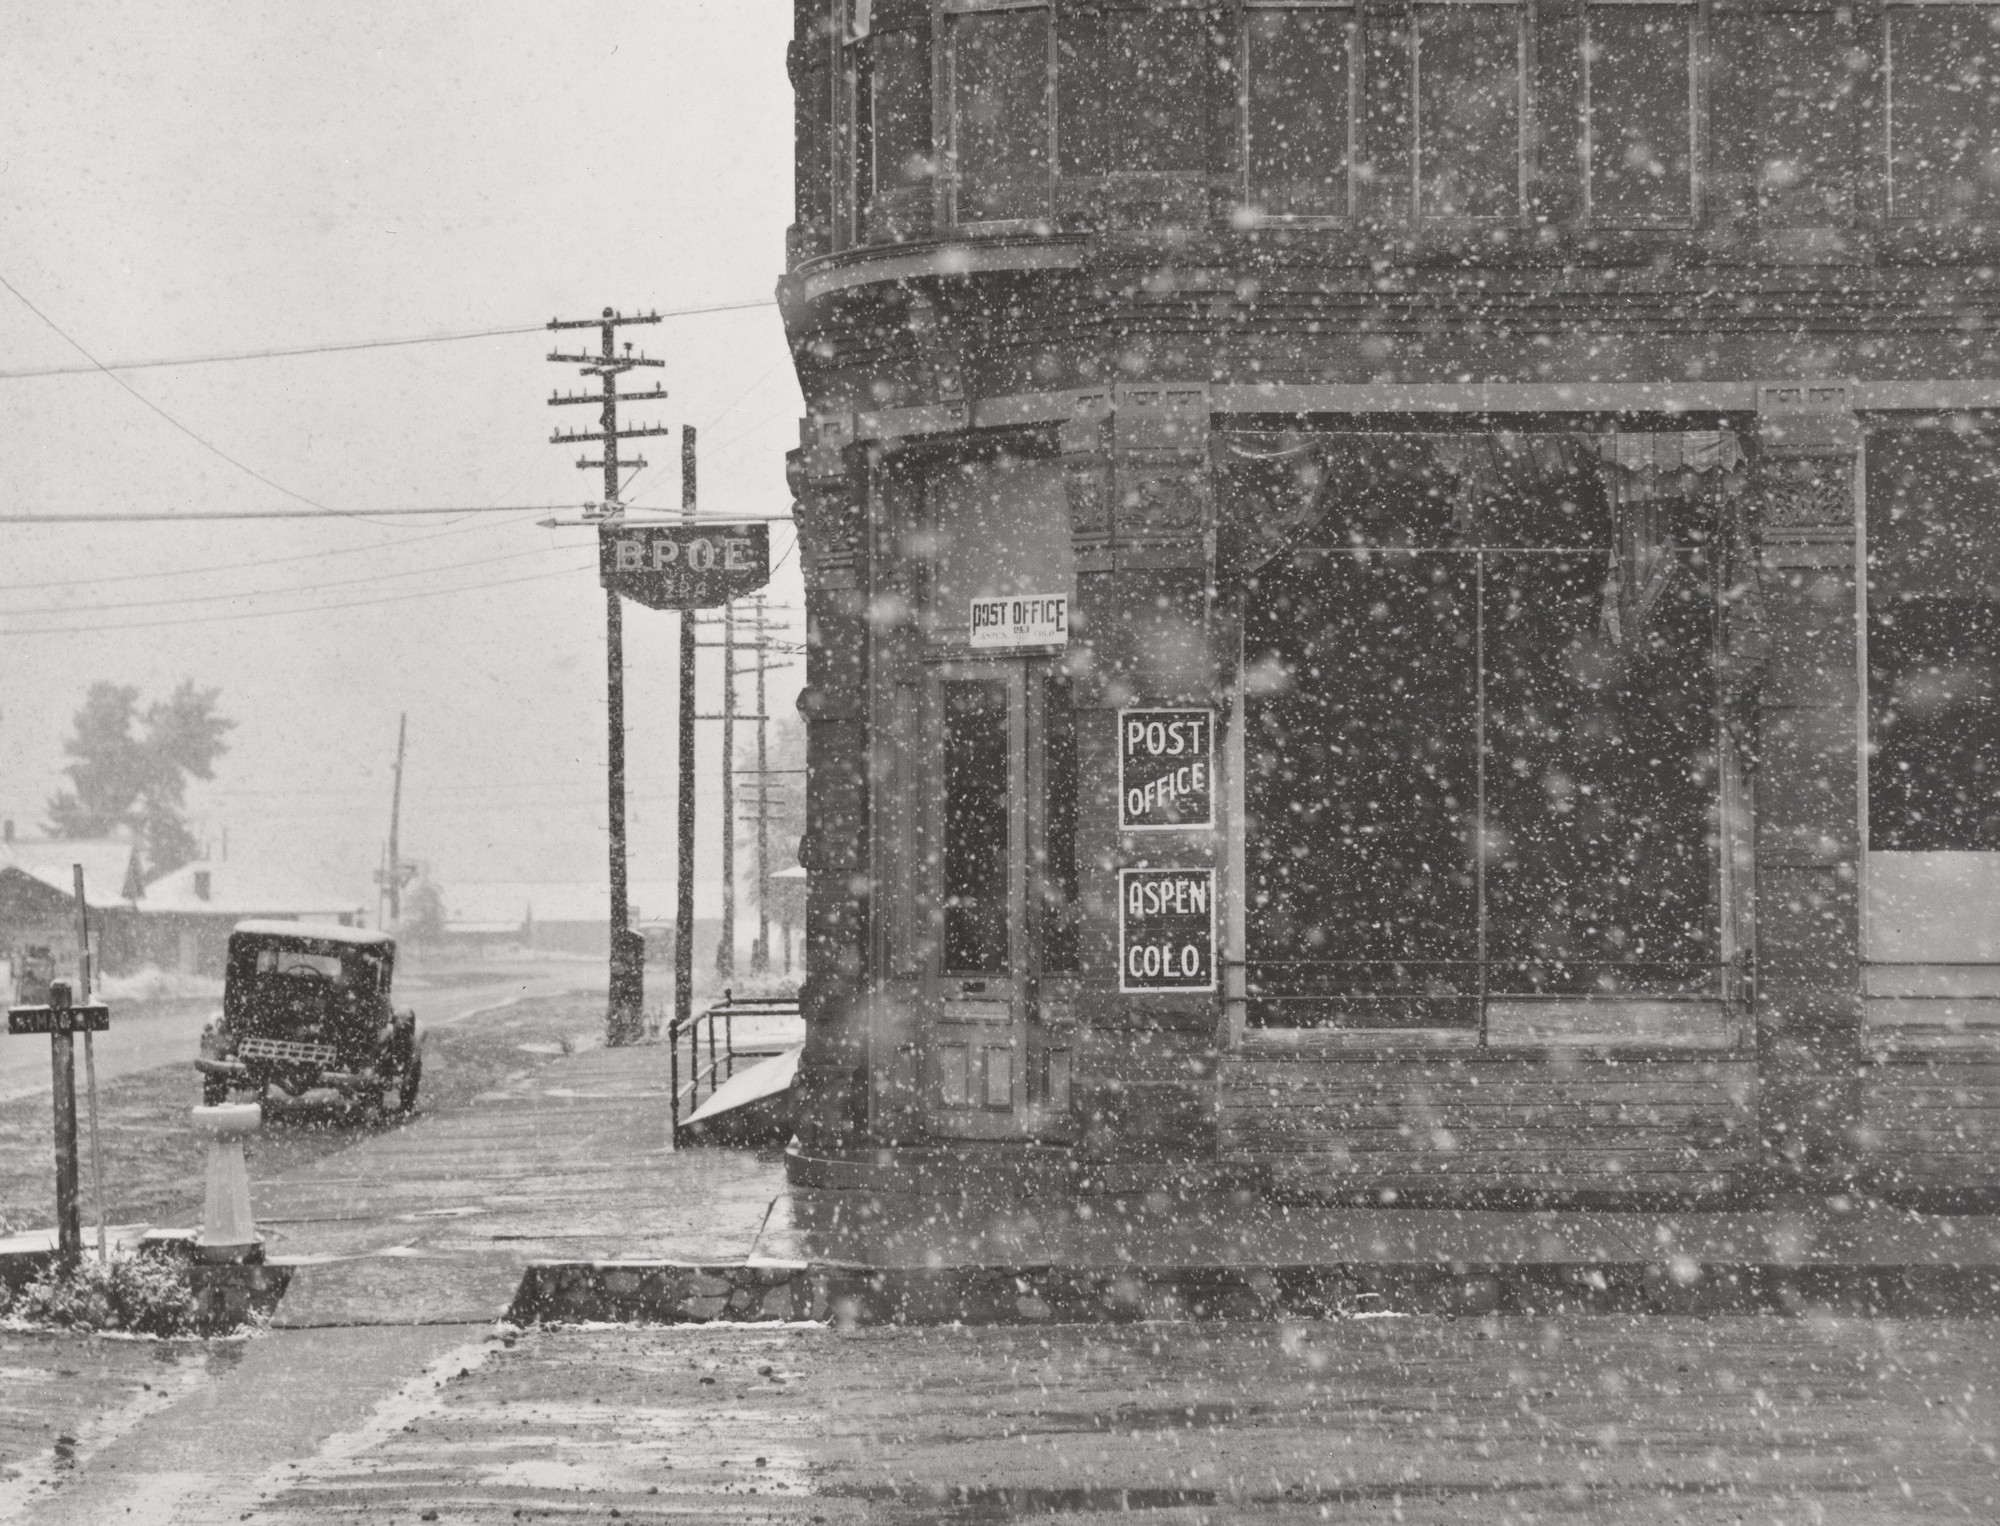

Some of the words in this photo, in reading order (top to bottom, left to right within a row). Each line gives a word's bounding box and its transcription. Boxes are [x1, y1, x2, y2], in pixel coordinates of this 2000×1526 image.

[616, 538, 757, 571] BPOE
[973, 602, 1007, 636] POST
[1013, 599, 1065, 632] OFFICE
[1128, 721, 1204, 755] POST
[1128, 762, 1204, 816] OFFICE
[1129, 880, 1205, 914] ASPEN
[1129, 944, 1206, 977] COLO.
